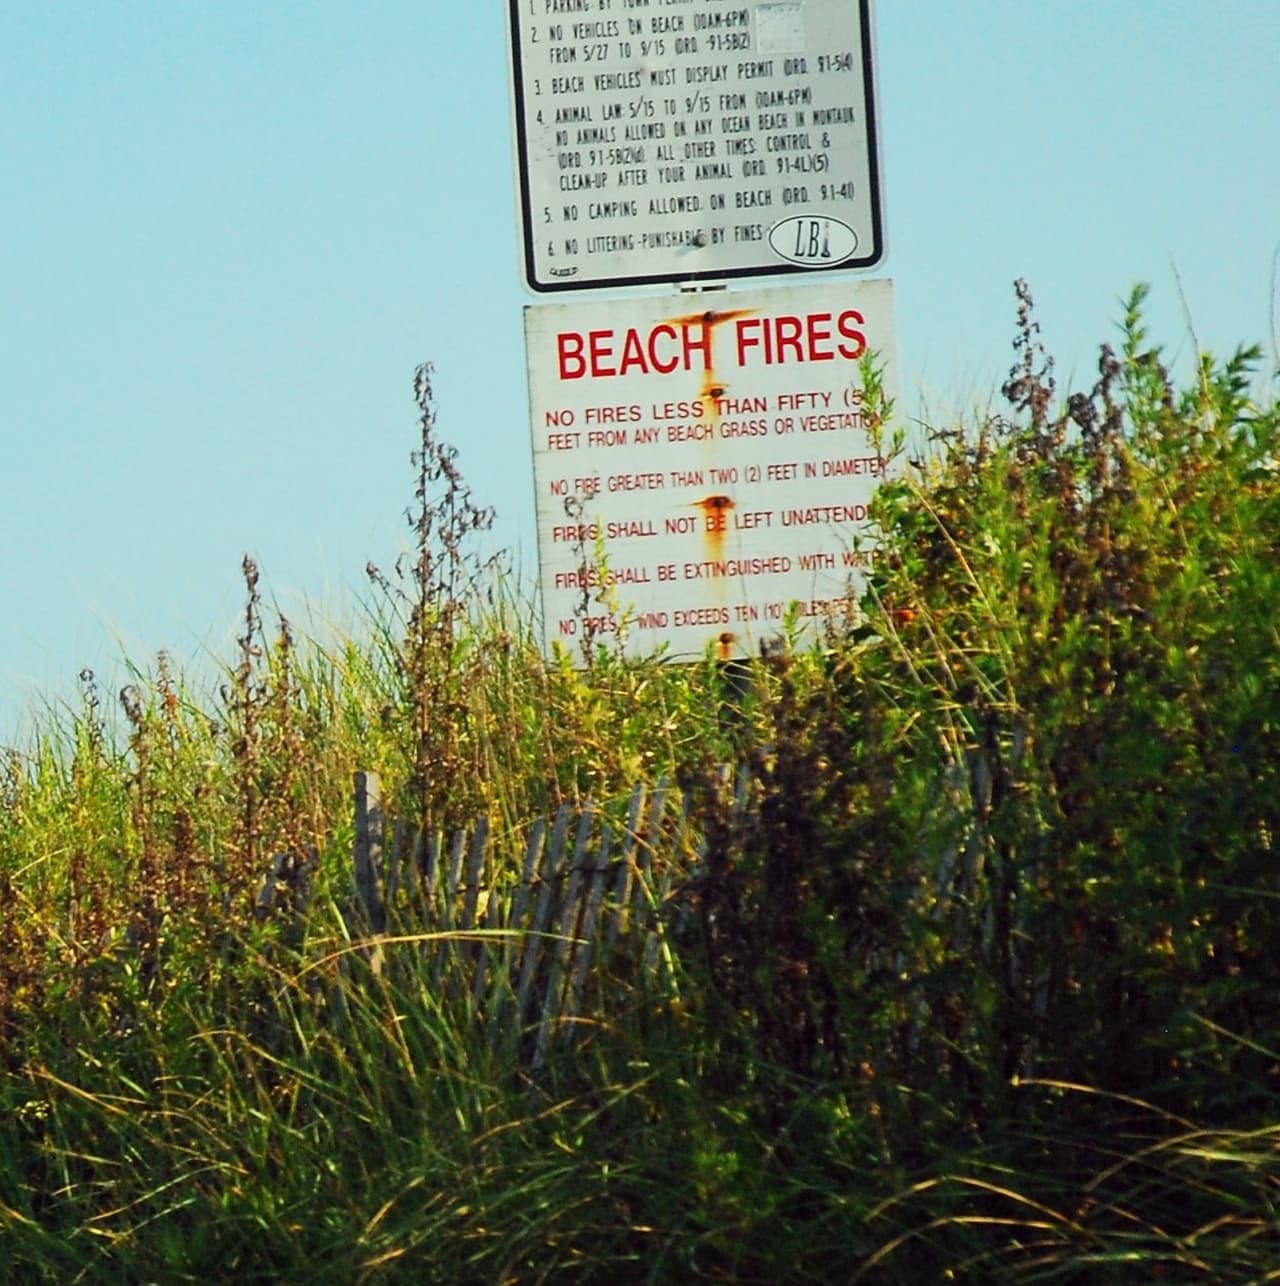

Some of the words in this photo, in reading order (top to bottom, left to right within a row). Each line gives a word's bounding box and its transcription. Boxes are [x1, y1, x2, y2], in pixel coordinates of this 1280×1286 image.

[549, 25, 563, 41] NO
[572, 21, 620, 39] VEHICLES
[628, 18, 642, 35] ON
[651, 16, 685, 33] BEACH
[550, 47, 577, 64] FROM
[583, 44, 609, 62] 5/27
[619, 42, 632, 58] TO
[641, 40, 665, 56] 9/15
[552, 76, 585, 94] BEACH
[594, 71, 641, 91] VEHICLES
[651, 68, 676, 86] MUST
[686, 65, 728, 84] DISPLAY
[738, 60, 774, 79] PERMIT
[556, 106, 593, 124] ANIMAL
[629, 95, 655, 118] 5/15
[664, 99, 676, 115] TO
[686, 90, 710, 113] 9/15
[720, 93, 746, 111] FROM
[556, 130, 568, 146] NO
[577, 127, 616, 144] ANIMALS
[625, 123, 665, 141] ALLOWED
[674, 121, 687, 137] ON
[695, 119, 713, 135] ANY
[722, 116, 750, 134] OCEAN
[759, 112, 787, 131] BEACH
[795, 111, 804, 127] IN
[813, 107, 855, 126] MONTAUK
[657, 144, 674, 161] ALL
[684, 141, 716, 160] OTHER
[767, 134, 812, 152] CONTROL
[822, 132, 831, 148] &
[560, 172, 607, 191] CLEAN-UP
[618, 169, 647, 188] AFTER
[658, 166, 685, 183] YOUR
[696, 163, 732, 181] ANIMAL
[563, 205, 578, 221] NO
[589, 200, 637, 220] CAMPING
[710, 194, 725, 210] ON
[735, 189, 772, 208] BEACH
[565, 239, 578, 255] NO
[711, 228, 725, 244] BY
[734, 224, 763, 242] FINES
[557, 321, 713, 380] BEACH
[735, 310, 867, 367] FIRES
[546, 410, 575, 427] NO
[585, 405, 642, 425] FIRES
[653, 401, 704, 420] LESS
[716, 396, 768, 416] THAN
[778, 391, 832, 411] FIFTY
[548, 433, 581, 450] FEET
[589, 429, 627, 448] FROM
[634, 428, 661, 444] ANY
[668, 424, 714, 442] BEACH
[720, 420, 768, 438] GRASS
[775, 418, 794, 434] OR
[550, 480, 568, 496] NO
[575, 477, 600, 495] FIRE
[608, 473, 664, 492] GREATER
[671, 470, 704, 487] THAN
[710, 468, 738, 484] TWO
[745, 464, 761, 483] (2)
[768, 464, 797, 480] FEET
[805, 461, 817, 477] IN
[553, 524, 599, 542] FIRES
[607, 522, 658, 538] SHALL
[666, 517, 696, 533] NOT
[706, 515, 726, 532] BE
[735, 511, 773, 530] LEFT
[555, 568, 598, 589] FIRES
[605, 567, 650, 585] SHALL
[658, 565, 677, 581] BE
[685, 556, 791, 579] EXTINGUISHED
[799, 553, 834, 571] WITH
[559, 619, 576, 635] NO
[638, 612, 669, 629] WIND
[675, 607, 729, 626] EXCEEDS
[735, 604, 758, 622] TEN
